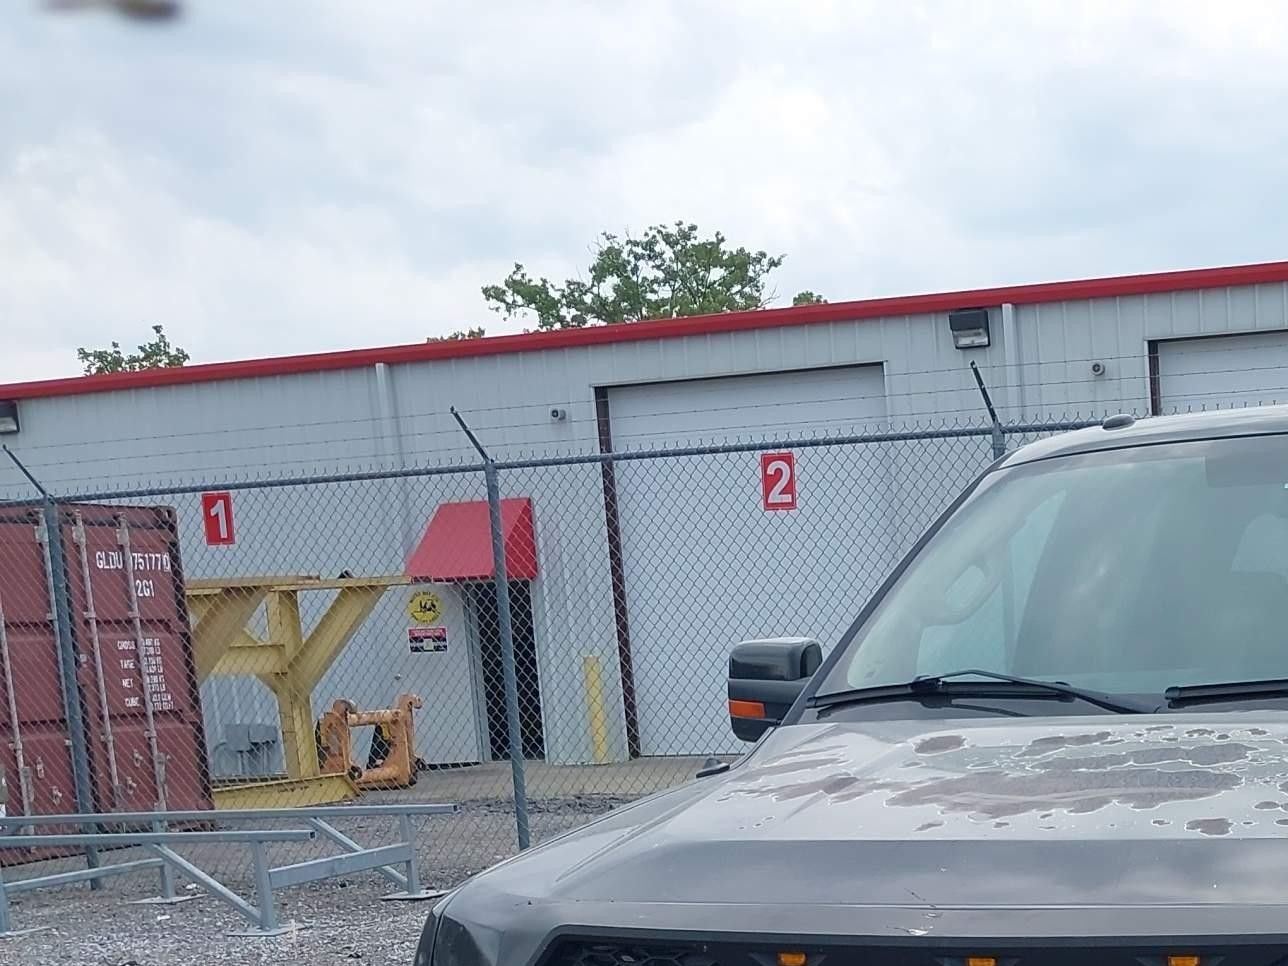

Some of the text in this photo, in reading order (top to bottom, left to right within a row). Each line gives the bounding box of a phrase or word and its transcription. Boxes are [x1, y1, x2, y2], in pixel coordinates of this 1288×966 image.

[766, 460, 793, 504] 2
[210, 499, 228, 539] 1
[96, 551, 171, 573] GLDU 751770
[135, 579, 155, 598] 2G1
